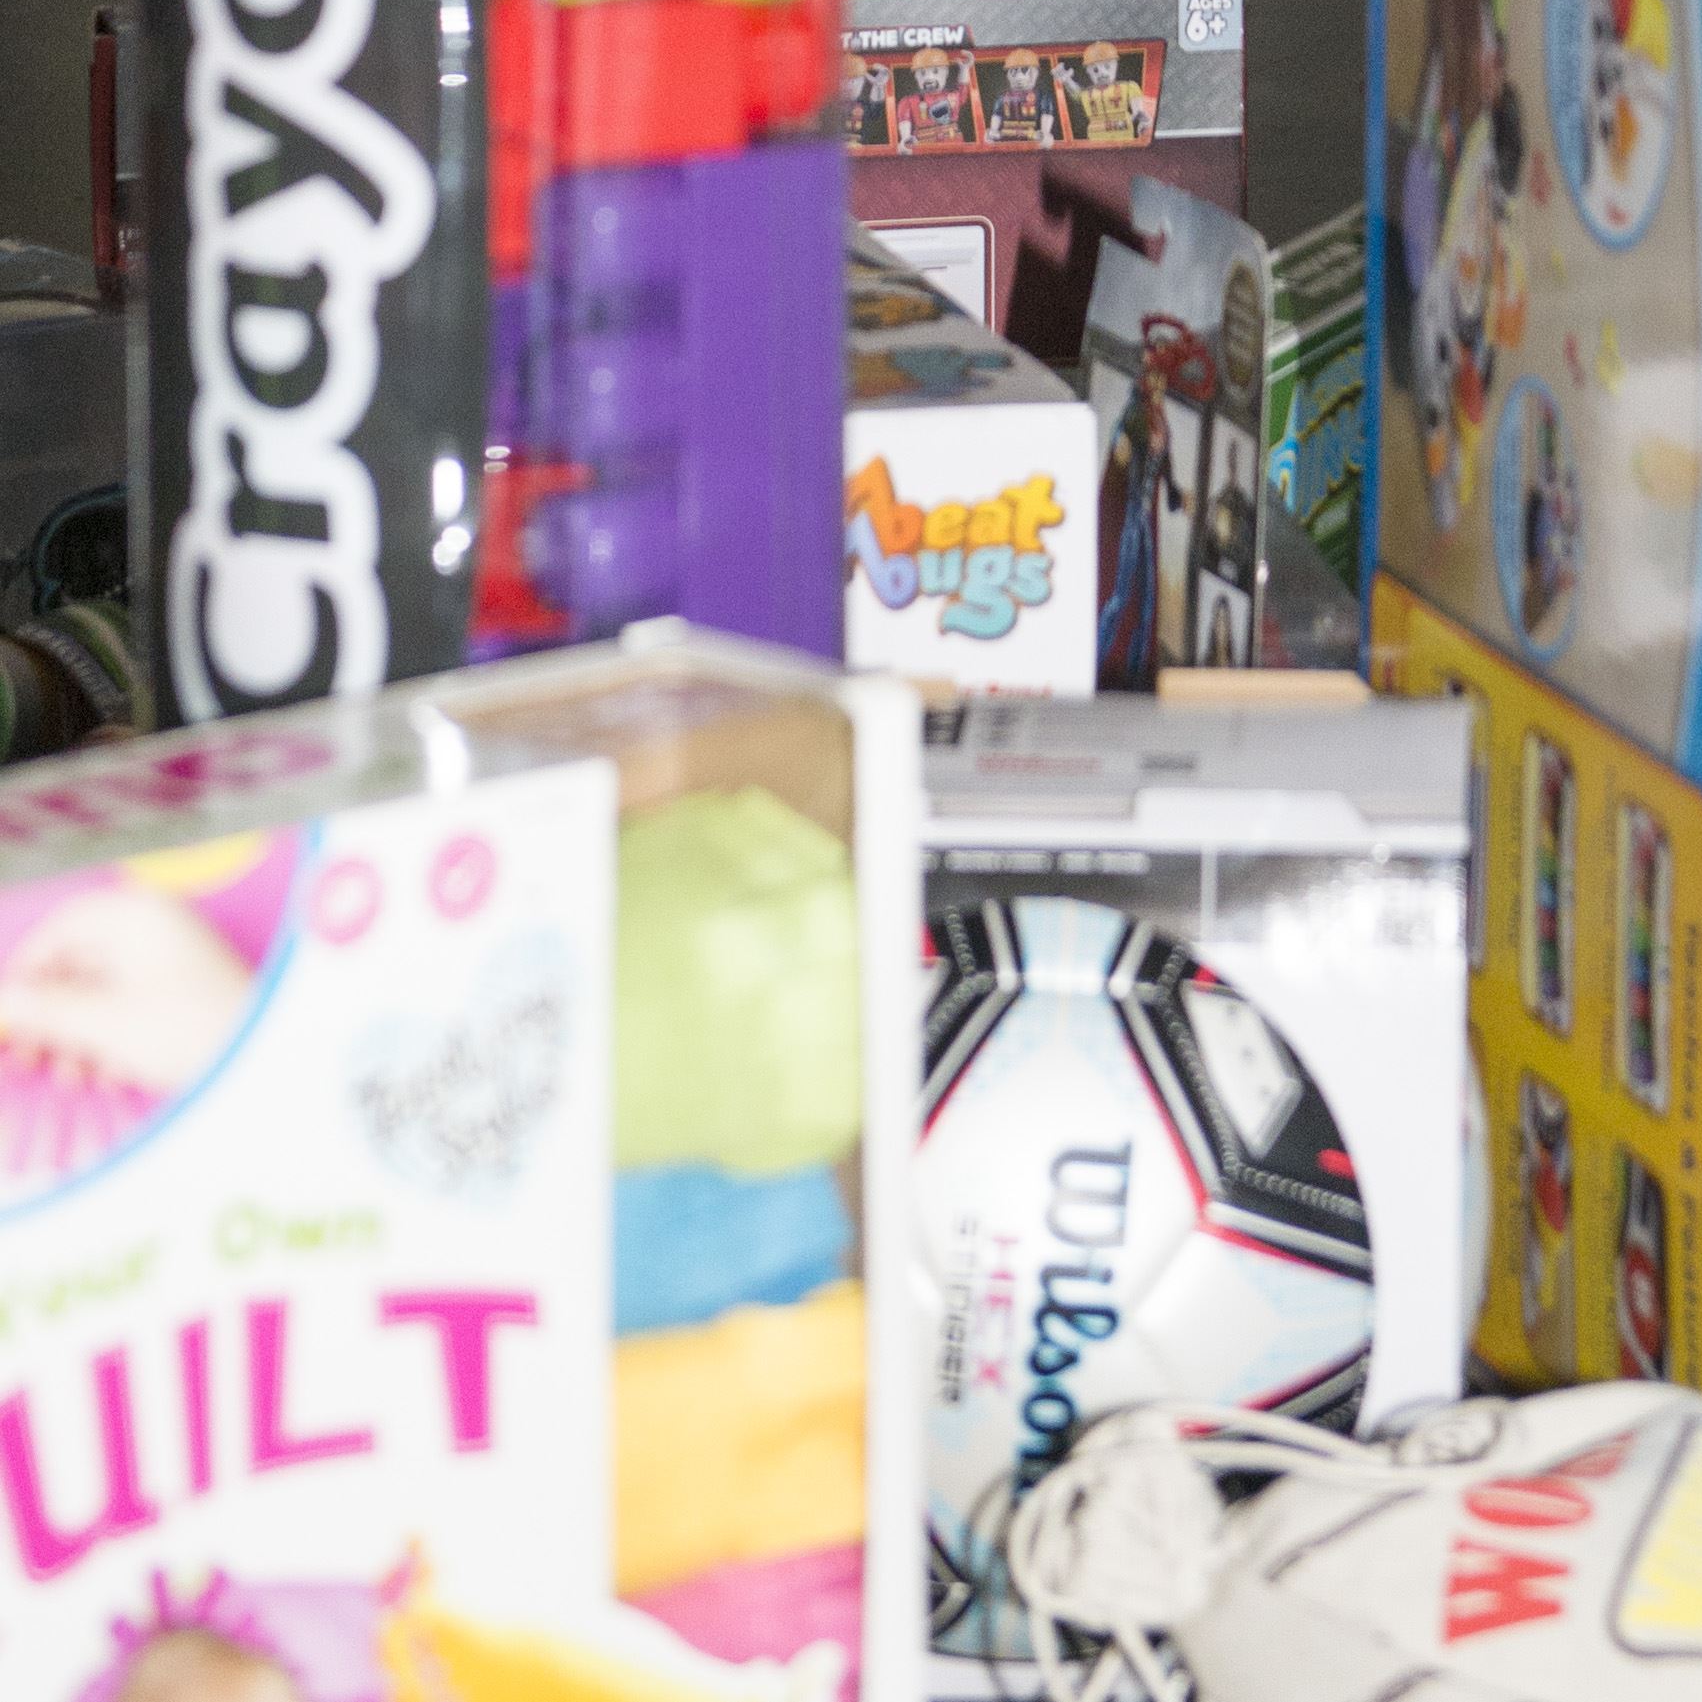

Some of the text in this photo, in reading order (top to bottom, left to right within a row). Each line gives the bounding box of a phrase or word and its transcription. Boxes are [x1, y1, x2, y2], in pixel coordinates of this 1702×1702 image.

[859, 30, 899, 49] THE
[903, 25, 966, 47] CREW
[1186, 9, 1228, 43] 6+
[846, 453, 1065, 557] beat
[846, 511, 1054, 640] bugs
[0, 1200, 386, 1339] our Own
[0, 1290, 540, 1583] UILT
